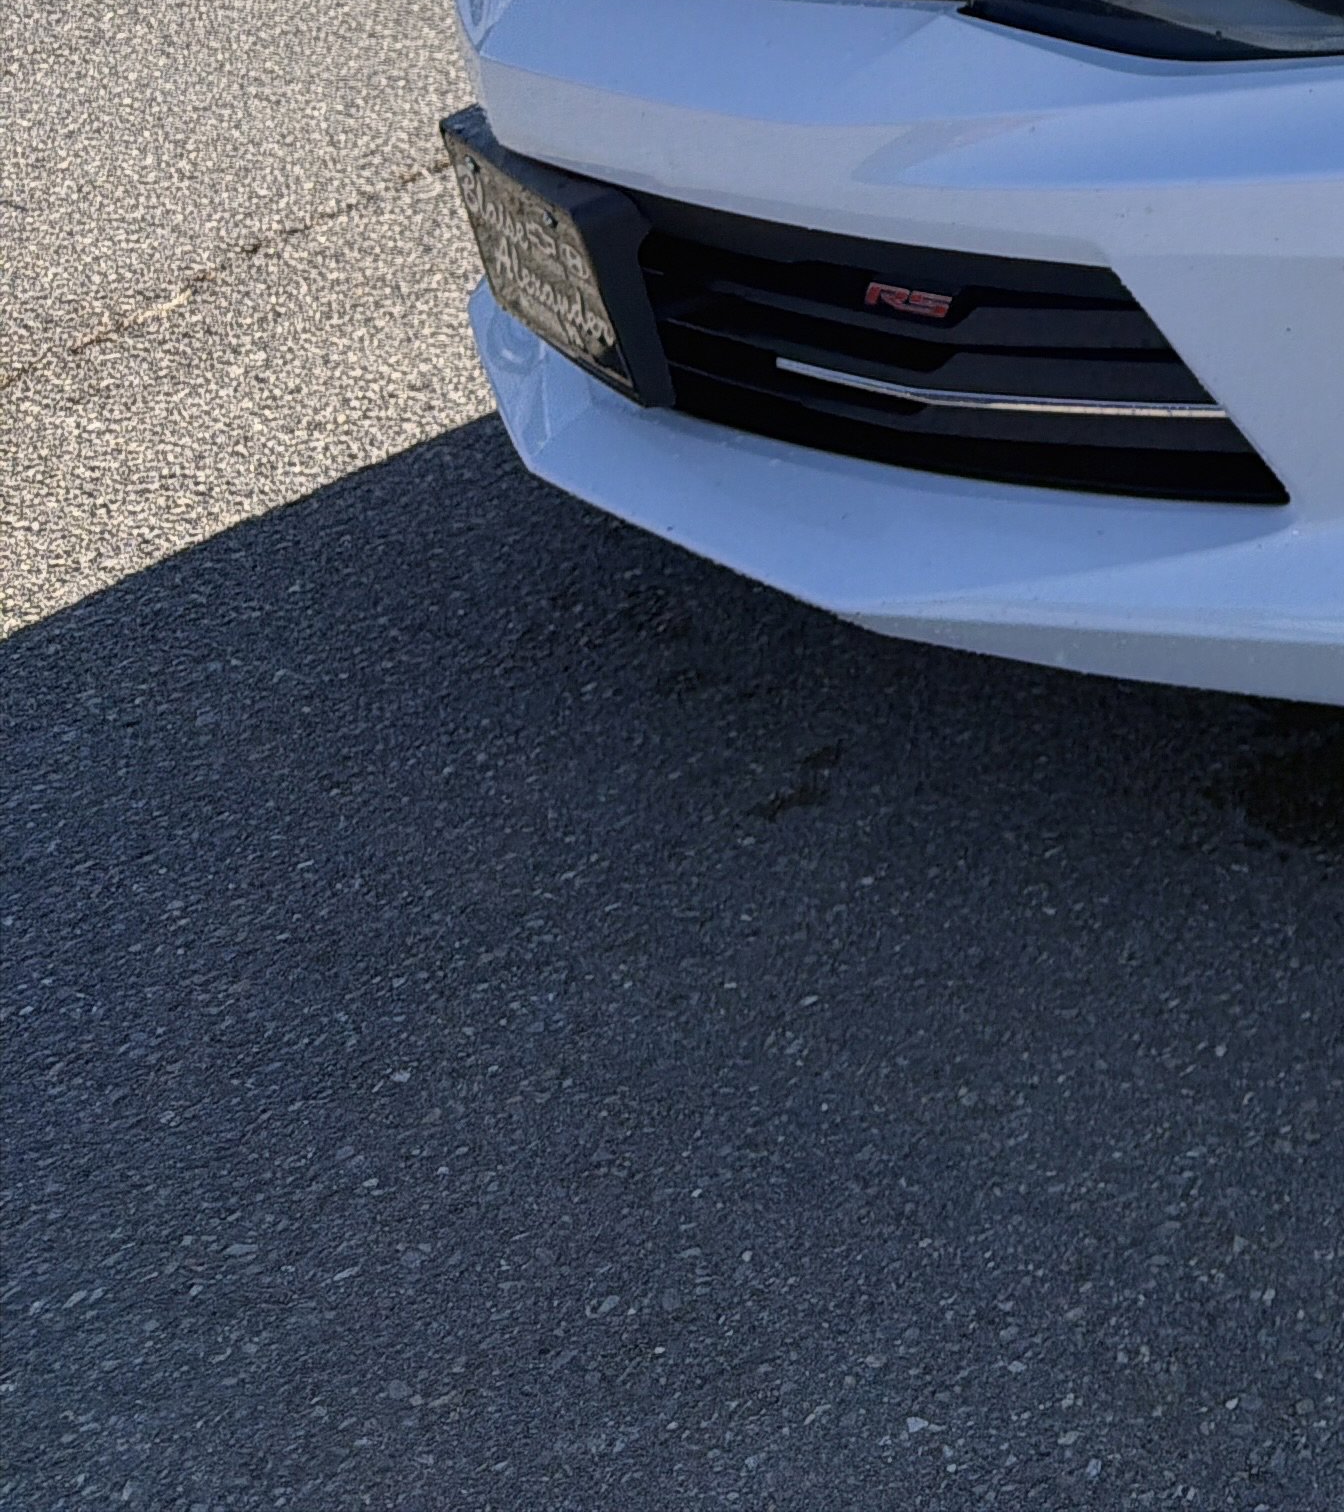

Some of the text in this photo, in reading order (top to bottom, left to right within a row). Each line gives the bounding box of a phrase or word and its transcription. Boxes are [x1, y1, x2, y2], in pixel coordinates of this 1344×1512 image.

[456, 163, 530, 250] Blaise
[495, 236, 618, 347] Alexander
[864, 282, 953, 318] RS
